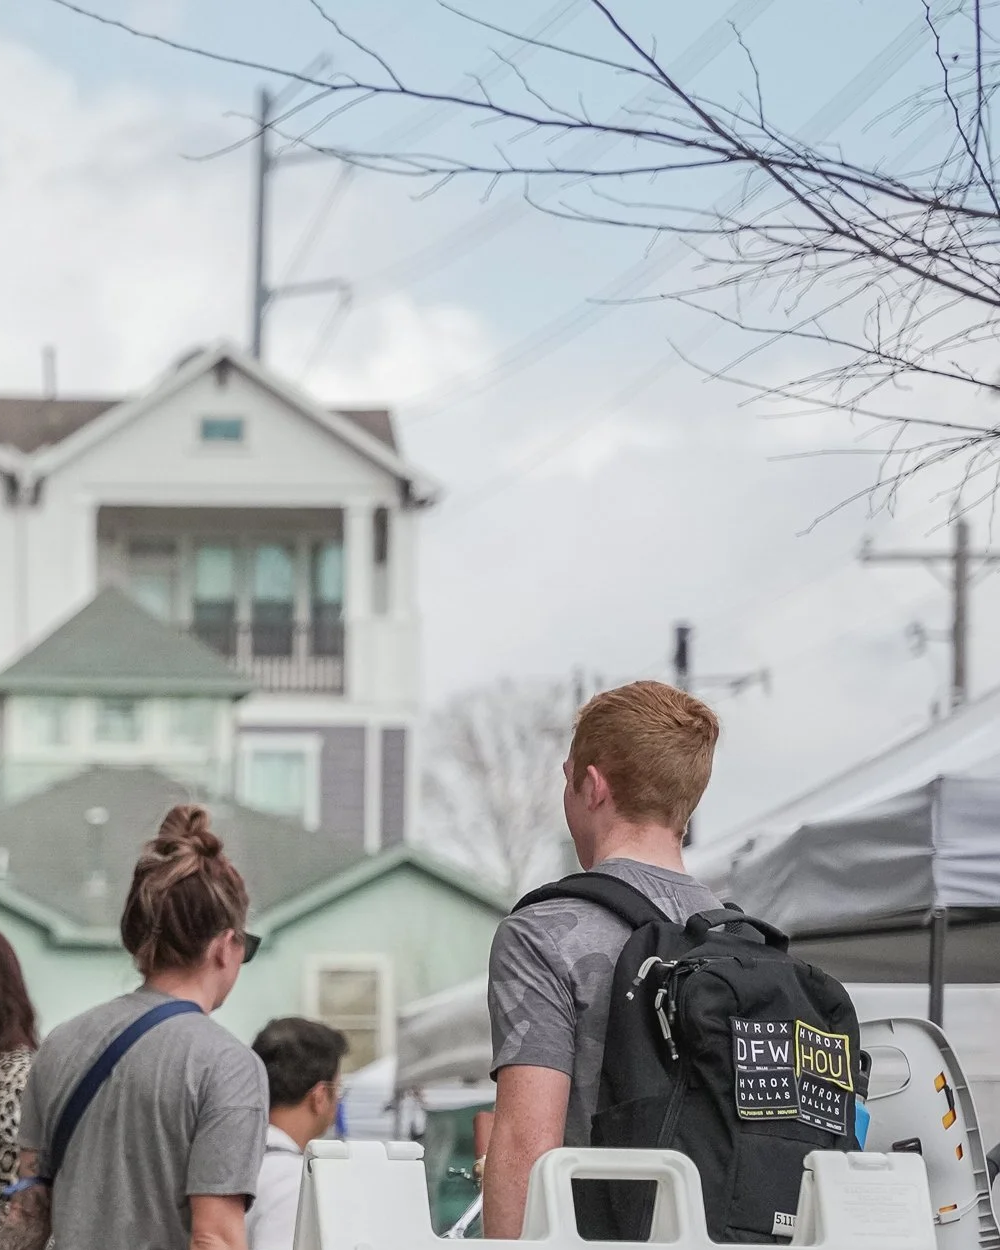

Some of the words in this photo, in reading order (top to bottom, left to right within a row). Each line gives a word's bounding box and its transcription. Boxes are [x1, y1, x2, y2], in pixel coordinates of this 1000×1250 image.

[734, 1020, 788, 1034] HYROX
[799, 1027, 843, 1050] HYROX
[737, 1037, 790, 1063] DFW
[801, 1044, 842, 1078] HOU
[739, 1077, 789, 1089] HYROX
[802, 1081, 841, 1104] HYROX
[740, 1091, 791, 1101] DALLAS
[801, 1094, 840, 1116] DALLAS
